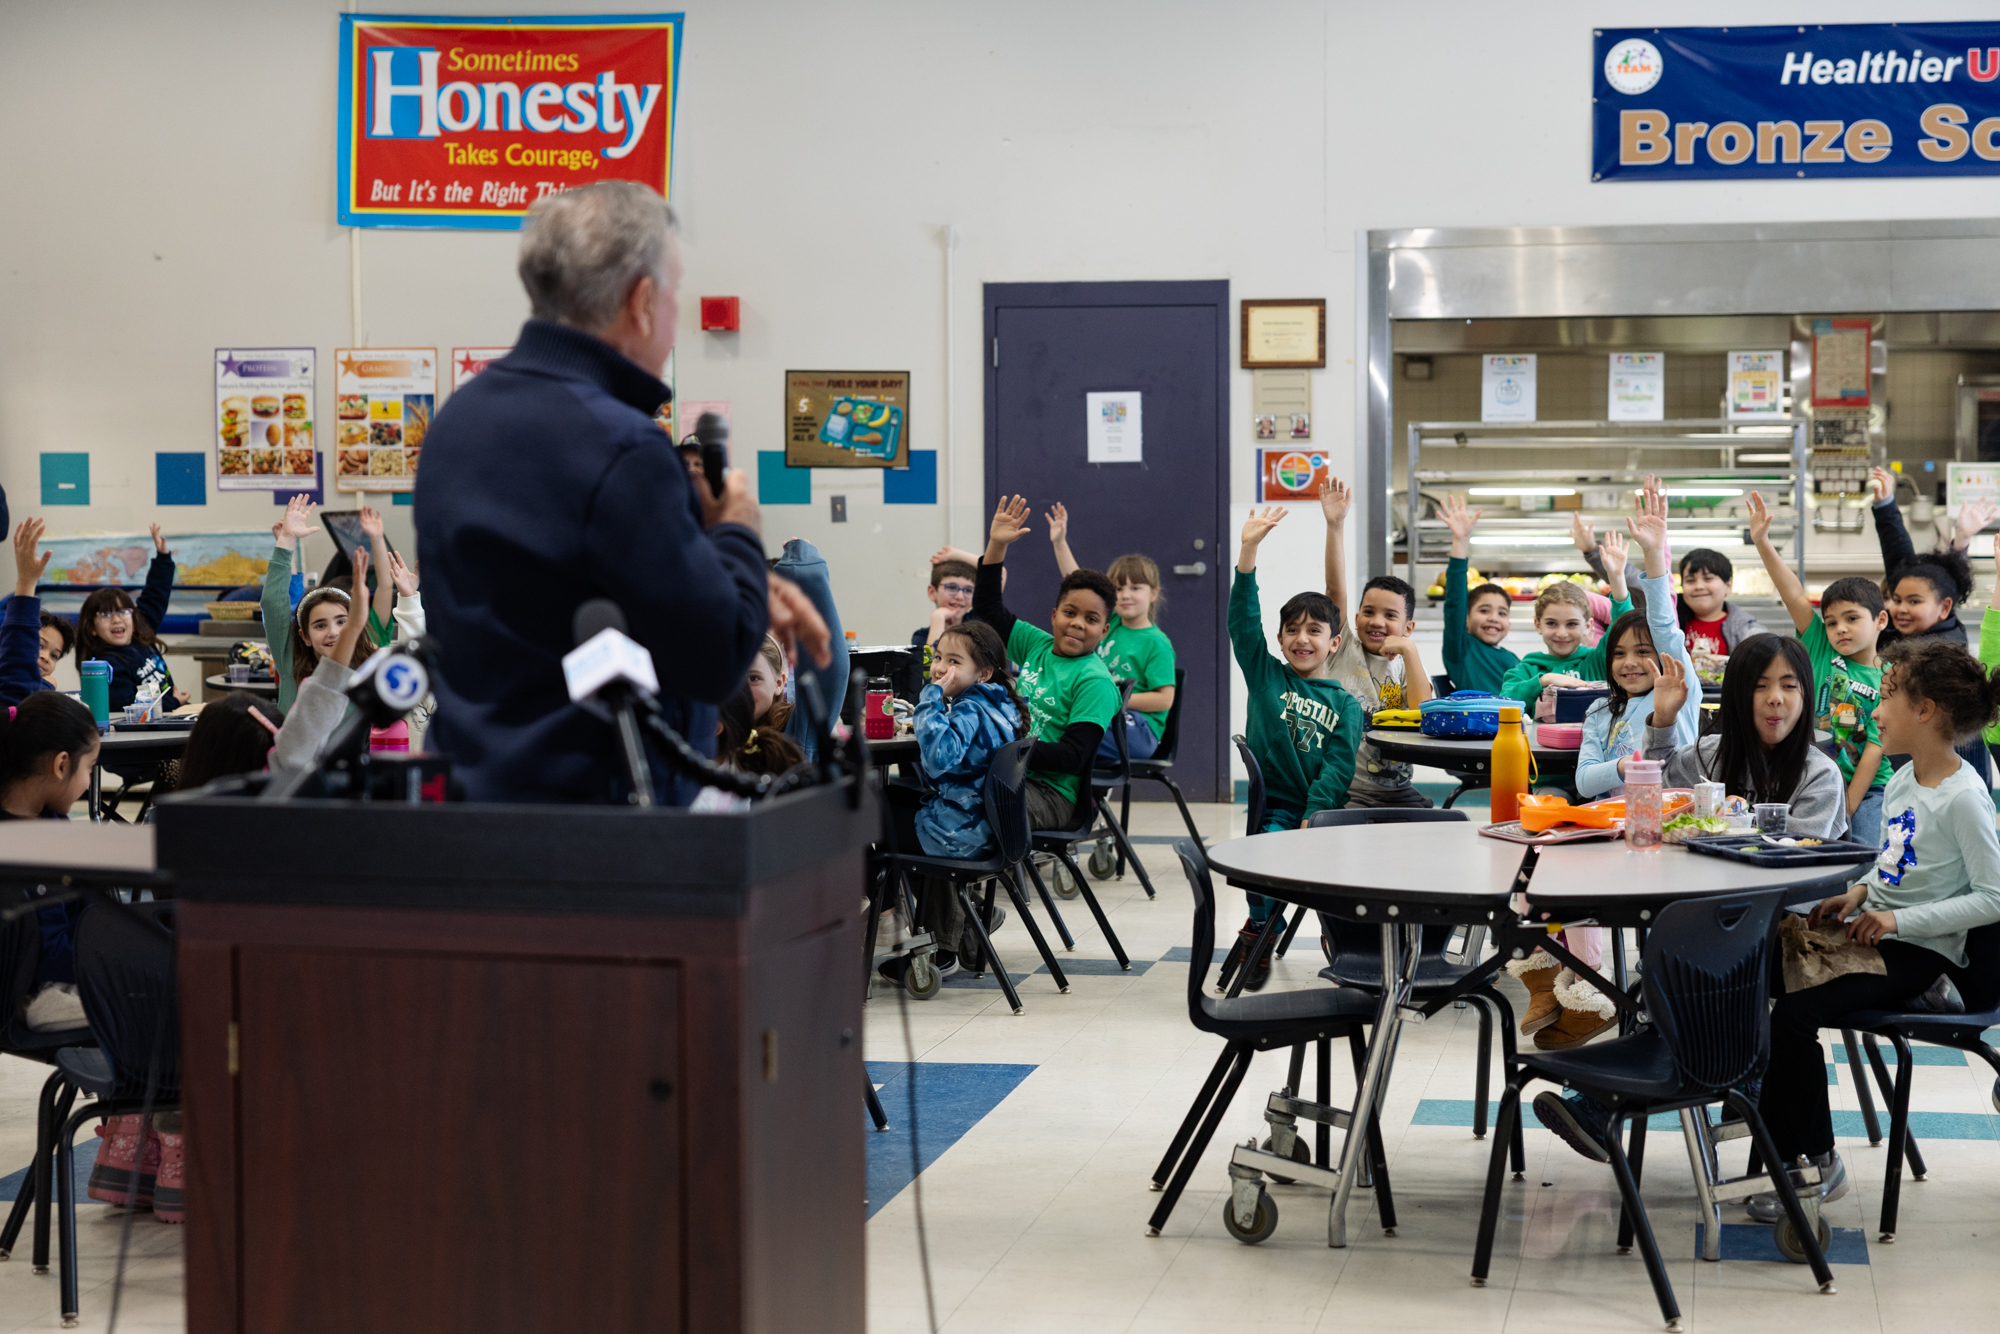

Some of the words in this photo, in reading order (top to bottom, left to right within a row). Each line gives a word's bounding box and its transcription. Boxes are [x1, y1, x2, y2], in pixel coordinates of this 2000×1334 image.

[447, 47, 579, 72] Sometimes
[1616, 64, 1652, 73] TEAM
[370, 51, 663, 159] Honesty
[1619, 109, 1893, 166] Bronze
[444, 143, 498, 166] Takes
[504, 143, 599, 171] Courage,
[370, 179, 401, 202] But
[408, 180, 437, 203] It's
[444, 181, 473, 203] the
[479, 181, 528, 208] Right
[535, 181, 582, 201] Thi
